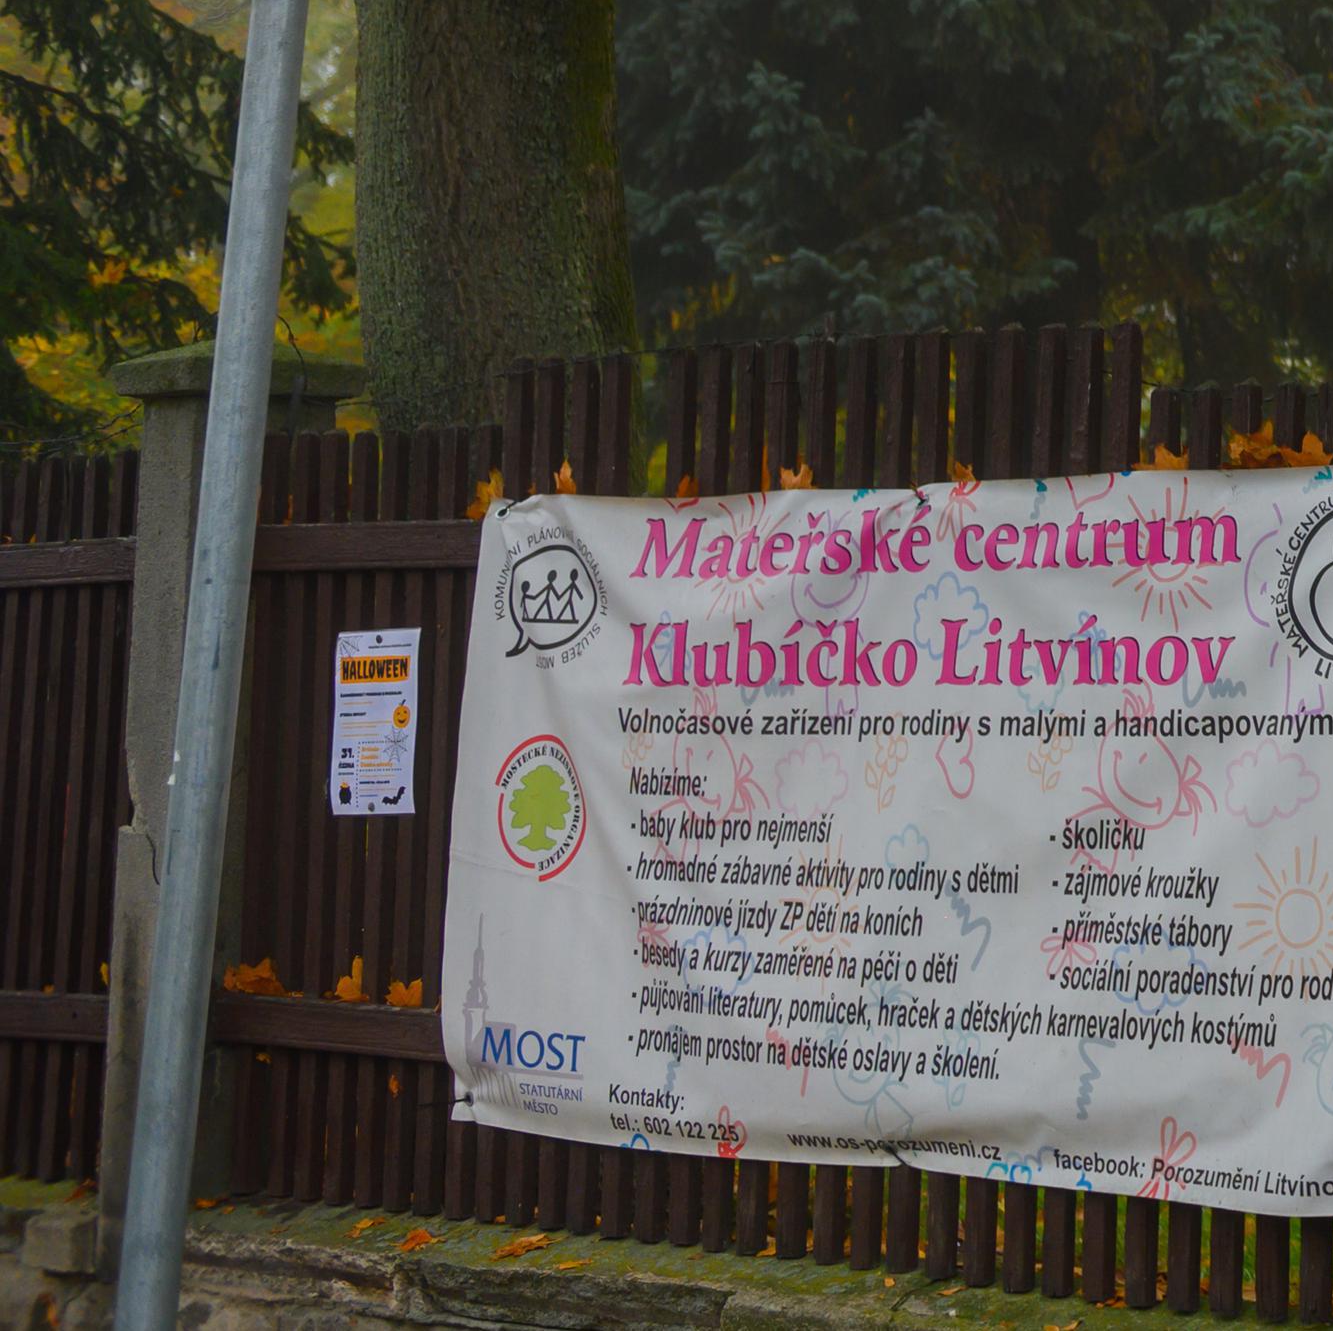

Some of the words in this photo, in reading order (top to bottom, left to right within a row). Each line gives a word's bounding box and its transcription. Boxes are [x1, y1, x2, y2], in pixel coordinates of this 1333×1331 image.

[629, 505, 933, 580] Mateřské
[953, 510, 1242, 572] centrum
[1270, 547, 1310, 659] MATEŘSKÉ
[560, 622, 602, 665] SLUŽEB
[622, 618, 919, 688] Klubíčko
[937, 614, 1236, 687] Litvínov
[342, 657, 409, 681] HALLOWEEN
[618, 705, 753, 736] Volnočasové
[760, 707, 853, 737] zařízení
[858, 714, 894, 743] pro
[900, 707, 970, 744] rodiny
[977, 714, 992, 738] s
[999, 707, 1085, 744] malými
[1093, 715, 1107, 738] a
[629, 766, 707, 798] Nabízíme:
[501, 743, 547, 790] MOSTECKÉ
[537, 804, 581, 872] ORGANIZACE
[639, 809, 676, 846] baby
[678, 811, 716, 841] klub
[720, 819, 751, 848] pro
[756, 813, 834, 850] nejmenší
[1062, 818, 1146, 851] školičku
[635, 851, 718, 885] hromadné
[720, 854, 793, 887] zábavné
[795, 857, 855, 897] aktivity
[856, 866, 884, 897] pro
[887, 861, 947, 900] rodiny
[951, 868, 961, 893] s
[967, 862, 1019, 895] dětmi
[1063, 865, 1142, 905] zájmové
[1144, 866, 1220, 908] kroužky
[637, 894, 733, 928] prázdninové
[734, 899, 777, 938] jízdy
[780, 901, 804, 931] ZP
[839, 909, 859, 935] na
[863, 905, 924, 937] koních
[1061, 910, 1163, 950] příměstské
[1168, 914, 1233, 957] tábory
[641, 936, 686, 976] besedy
[689, 948, 700, 971] a
[702, 941, 752, 981] kurzy
[753, 945, 835, 977] zaměřené
[836, 954, 857, 980] na
[860, 950, 901, 988] péči
[905, 959, 917, 983] o
[922, 952, 959, 985] děti
[1059, 959, 1133, 993] sociální
[1135, 963, 1257, 1001] poradenství
[1258, 973, 1294, 1006] pro
[639, 978, 706, 1016] půjčování
[708, 985, 784, 1027] literatury,
[786, 992, 872, 1032] pomůcek,
[877, 995, 939, 1030] hraček
[944, 1006, 956, 1031] a
[960, 1000, 1042, 1042] dětských
[1046, 1004, 1186, 1050] karnevalových
[1190, 1011, 1278, 1055] kostýmů
[481, 1026, 586, 1072] MOST
[635, 1025, 702, 1063] pronájem
[705, 1034, 763, 1066] prostor
[766, 1040, 786, 1065] na
[791, 1037, 848, 1071] dětské
[852, 1041, 912, 1082] oslavy
[915, 1051, 927, 1075] a
[930, 1043, 1001, 1081] školení.
[519, 1082, 584, 1103] STATUTÁRNÍ
[523, 1099, 559, 1116] MĚSTO
[608, 1083, 685, 1115] Kontakty:
[610, 1112, 640, 1133] tel.:
[643, 1115, 673, 1138] 602
[675, 1119, 706, 1140] 122
[708, 1122, 740, 1143] 225
[1053, 1148, 1146, 1179] facebook:
[1150, 1157, 1261, 1193] Porozumění
